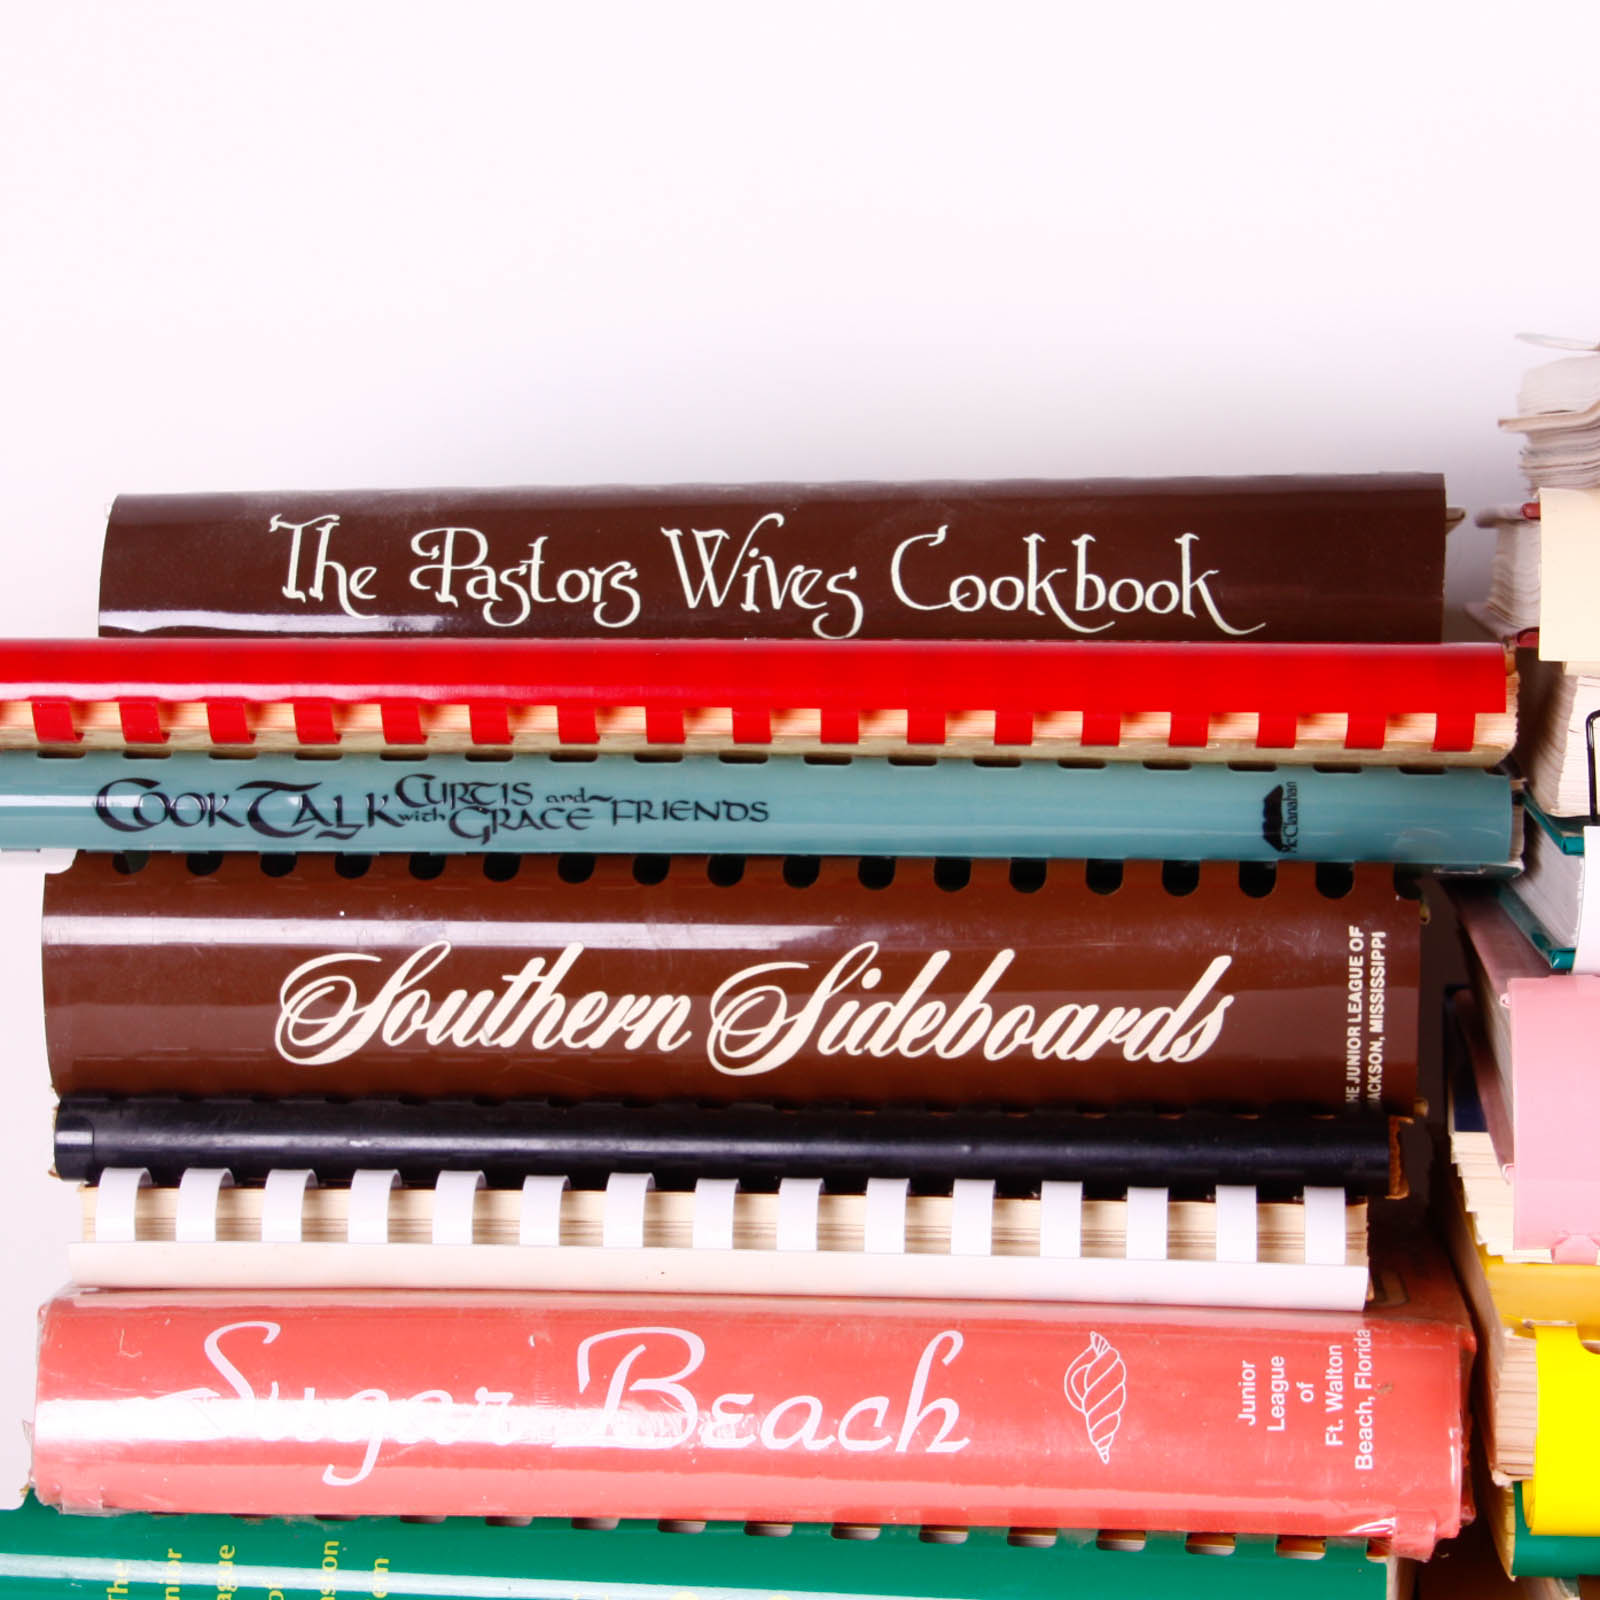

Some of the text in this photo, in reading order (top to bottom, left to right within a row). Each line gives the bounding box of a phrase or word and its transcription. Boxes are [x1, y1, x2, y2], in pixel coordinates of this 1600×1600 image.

[269, 513, 1266, 639] The Pastors Wives Cookbook
[612, 797, 769, 823] FRIENDS
[274, 941, 1235, 1076] Southern Sideboards
[1345, 925, 1365, 1103] HE JUNIOR LEAGUE OF
[1366, 931, 1387, 1104] ACKSON, MISSISSIPPI
[552, 1326, 971, 1453] Beach
[1237, 1359, 1256, 1426] Junior
[1266, 1355, 1290, 1431] League
[1296, 1381, 1315, 1403] of
[1325, 1344, 1344, 1446] Ft. Walton
[1353, 1329, 1376, 1470] Beach, Florida
